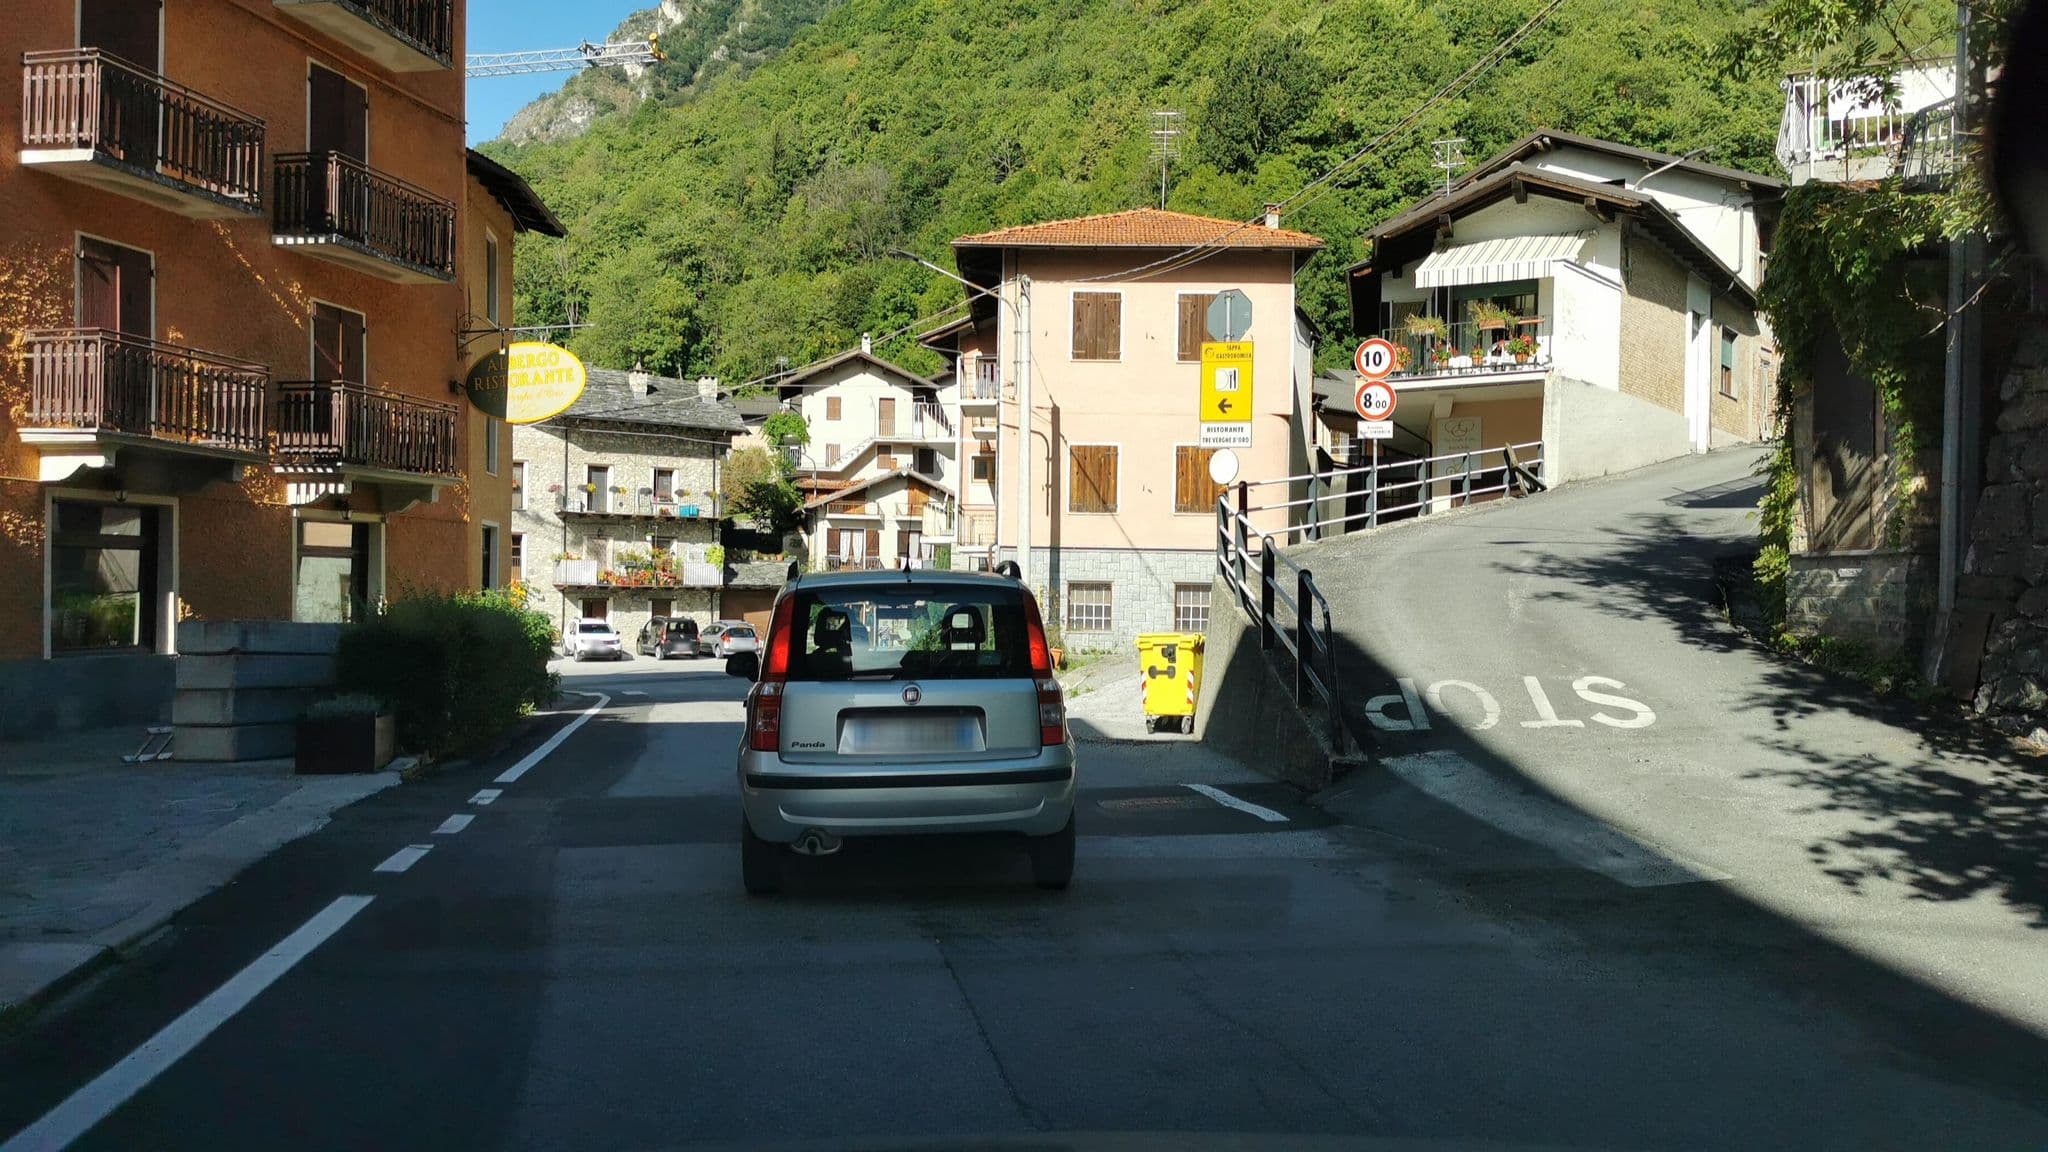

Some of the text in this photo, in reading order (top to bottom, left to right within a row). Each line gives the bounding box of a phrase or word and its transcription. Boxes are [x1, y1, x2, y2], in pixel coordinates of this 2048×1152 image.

[487, 352, 560, 371] ALBERGO
[474, 368, 574, 391] RISTORANTE
[1364, 676, 1656, 731] STOP
